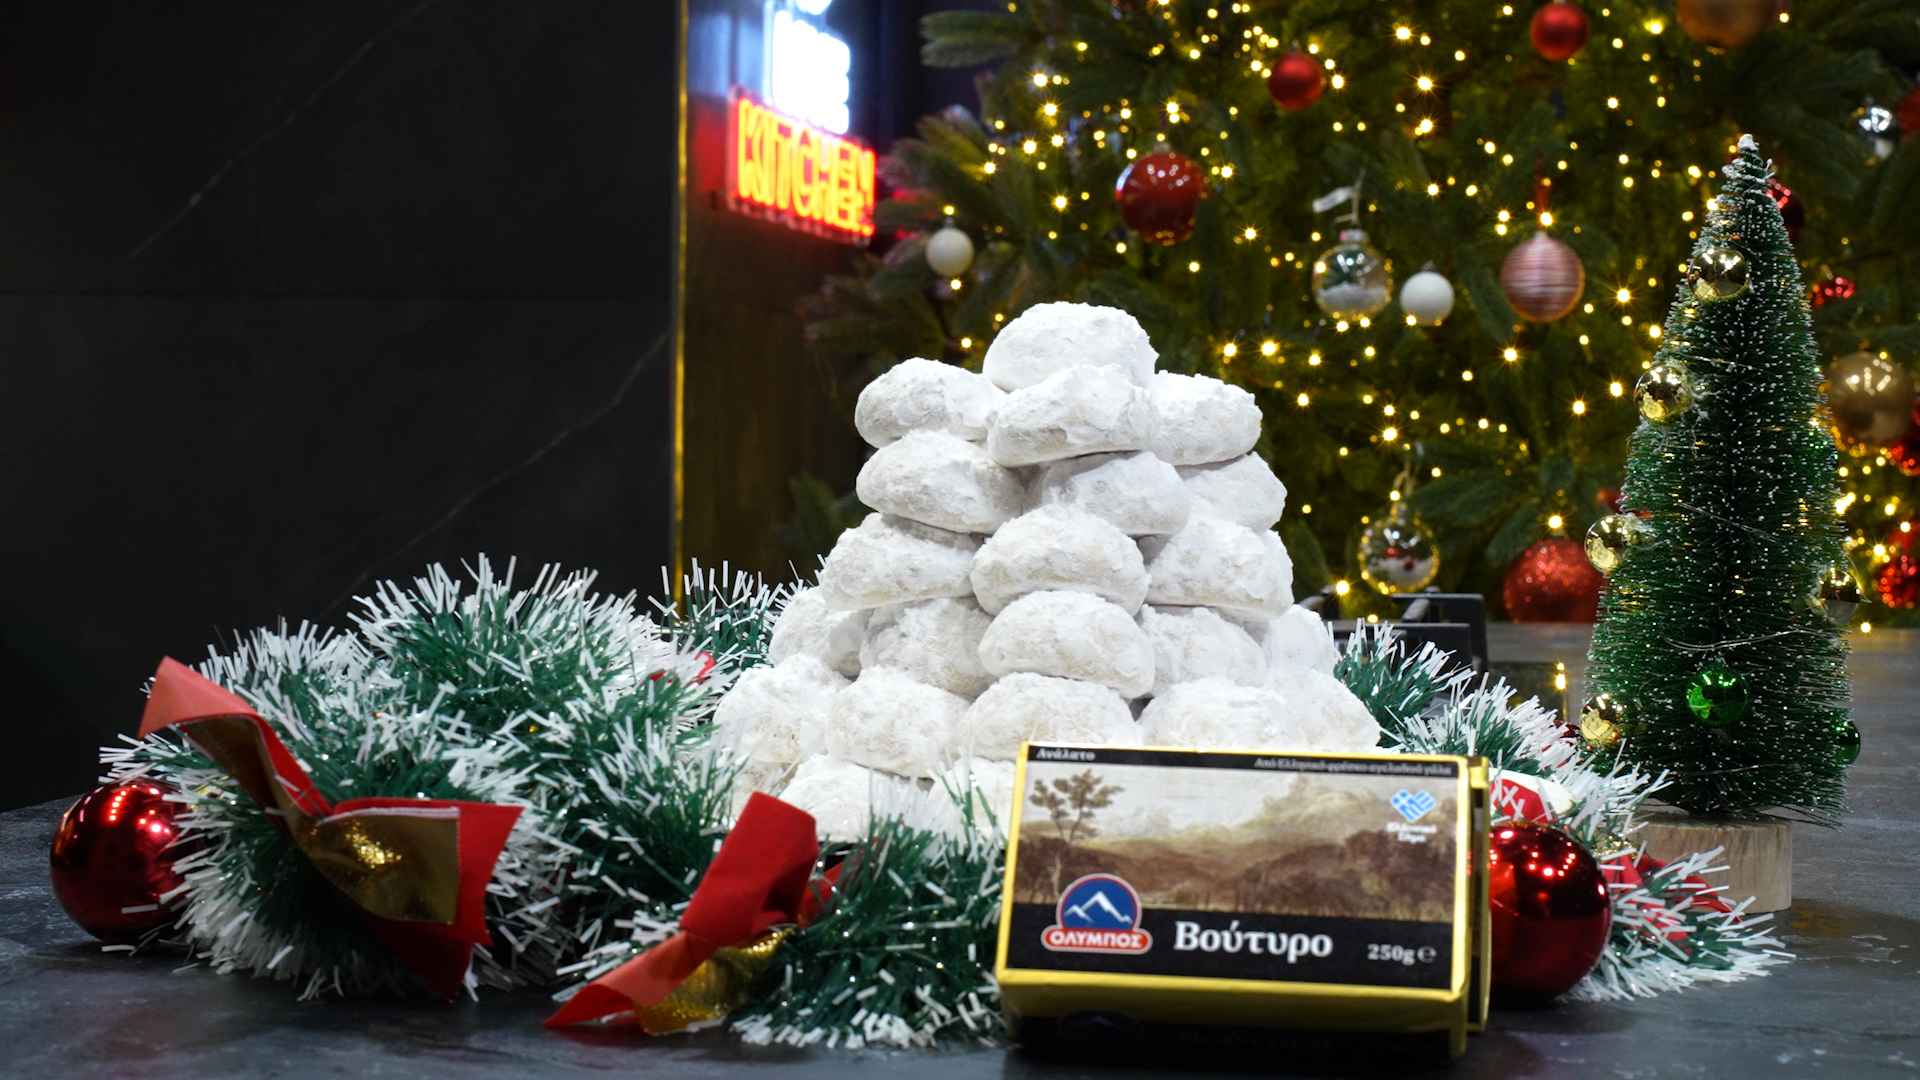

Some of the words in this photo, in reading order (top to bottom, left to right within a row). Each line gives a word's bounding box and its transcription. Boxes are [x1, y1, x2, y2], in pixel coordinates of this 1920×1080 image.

[1049, 930, 1142, 949] ΟΛΥΜΠΟΣ
[1174, 920, 1334, 964] Βούτυρο
[1367, 943, 1416, 966] 250g
